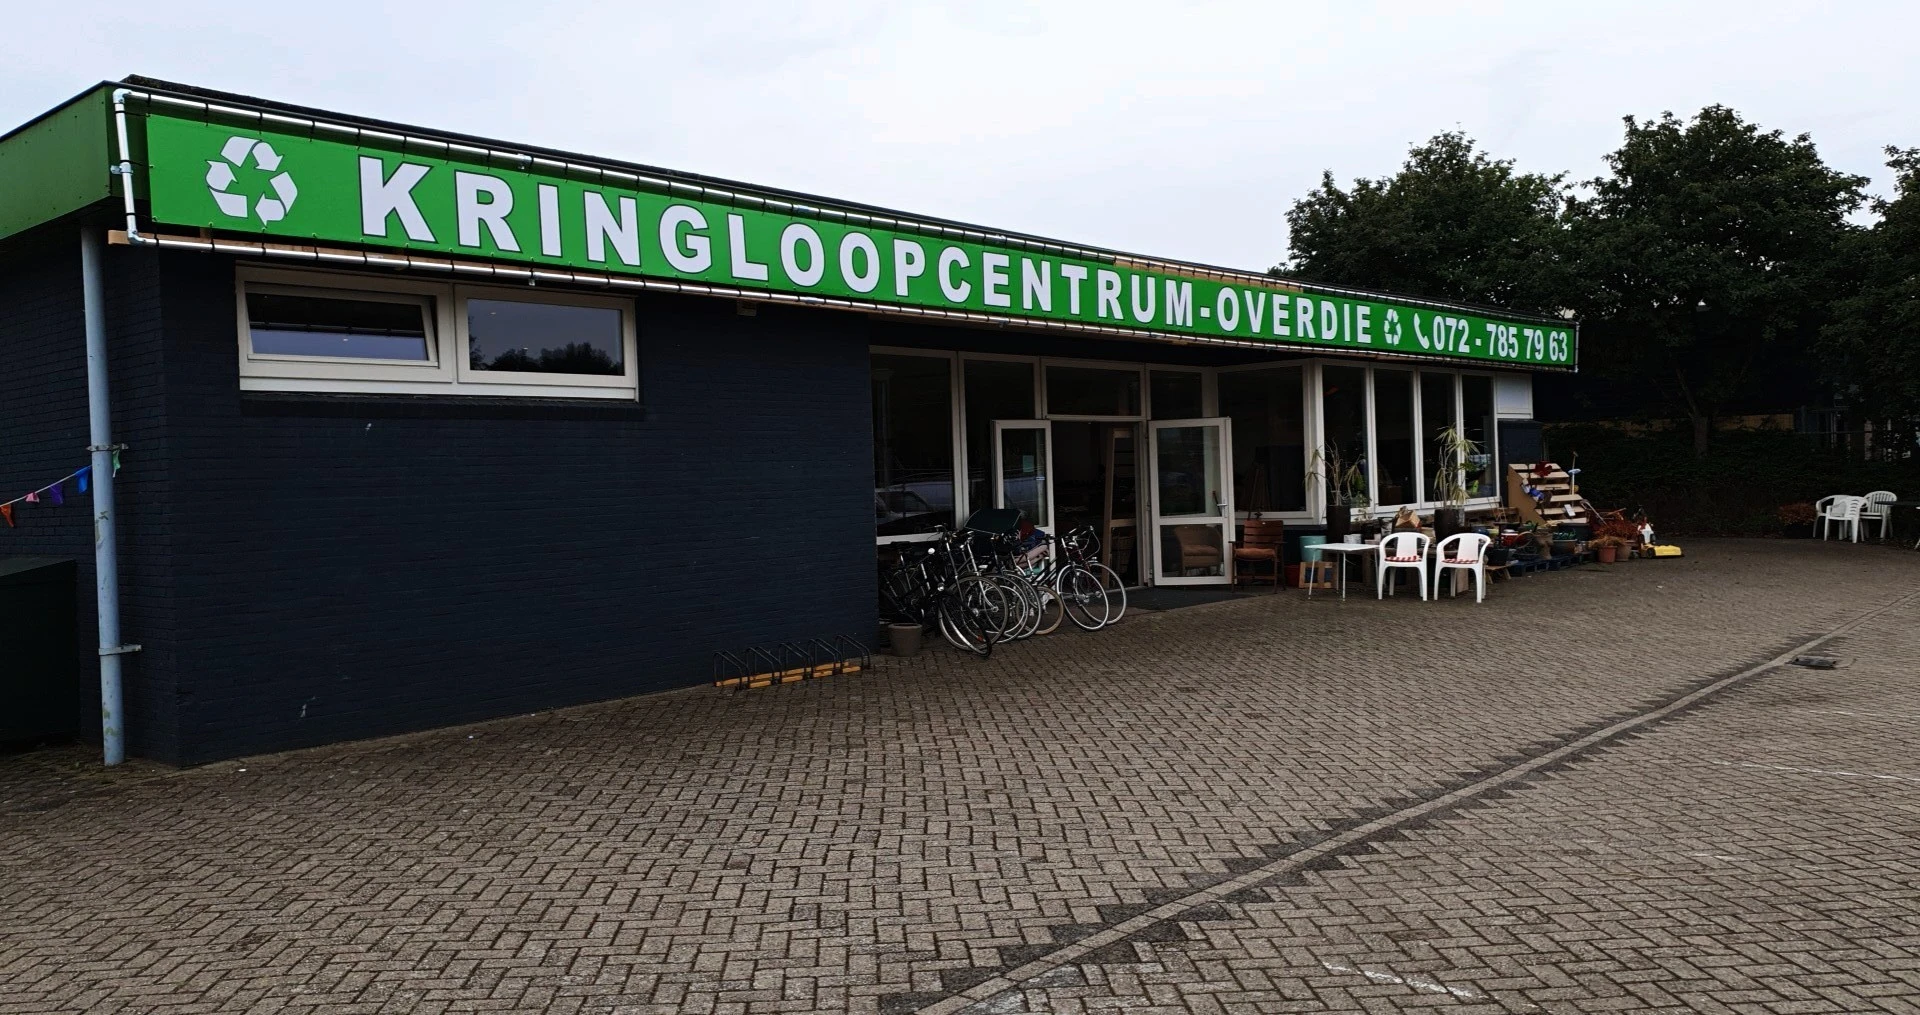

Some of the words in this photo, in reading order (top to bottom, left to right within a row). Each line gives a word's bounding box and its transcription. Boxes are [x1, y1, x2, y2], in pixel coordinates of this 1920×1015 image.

[358, 154, 1373, 345] KRINGLOOPCENTRUM-OVERDIE
[1433, 315, 1470, 353] 072
[1486, 323, 1519, 359] 785
[1523, 328, 1544, 361] 79
[1549, 330, 1568, 362] 63
